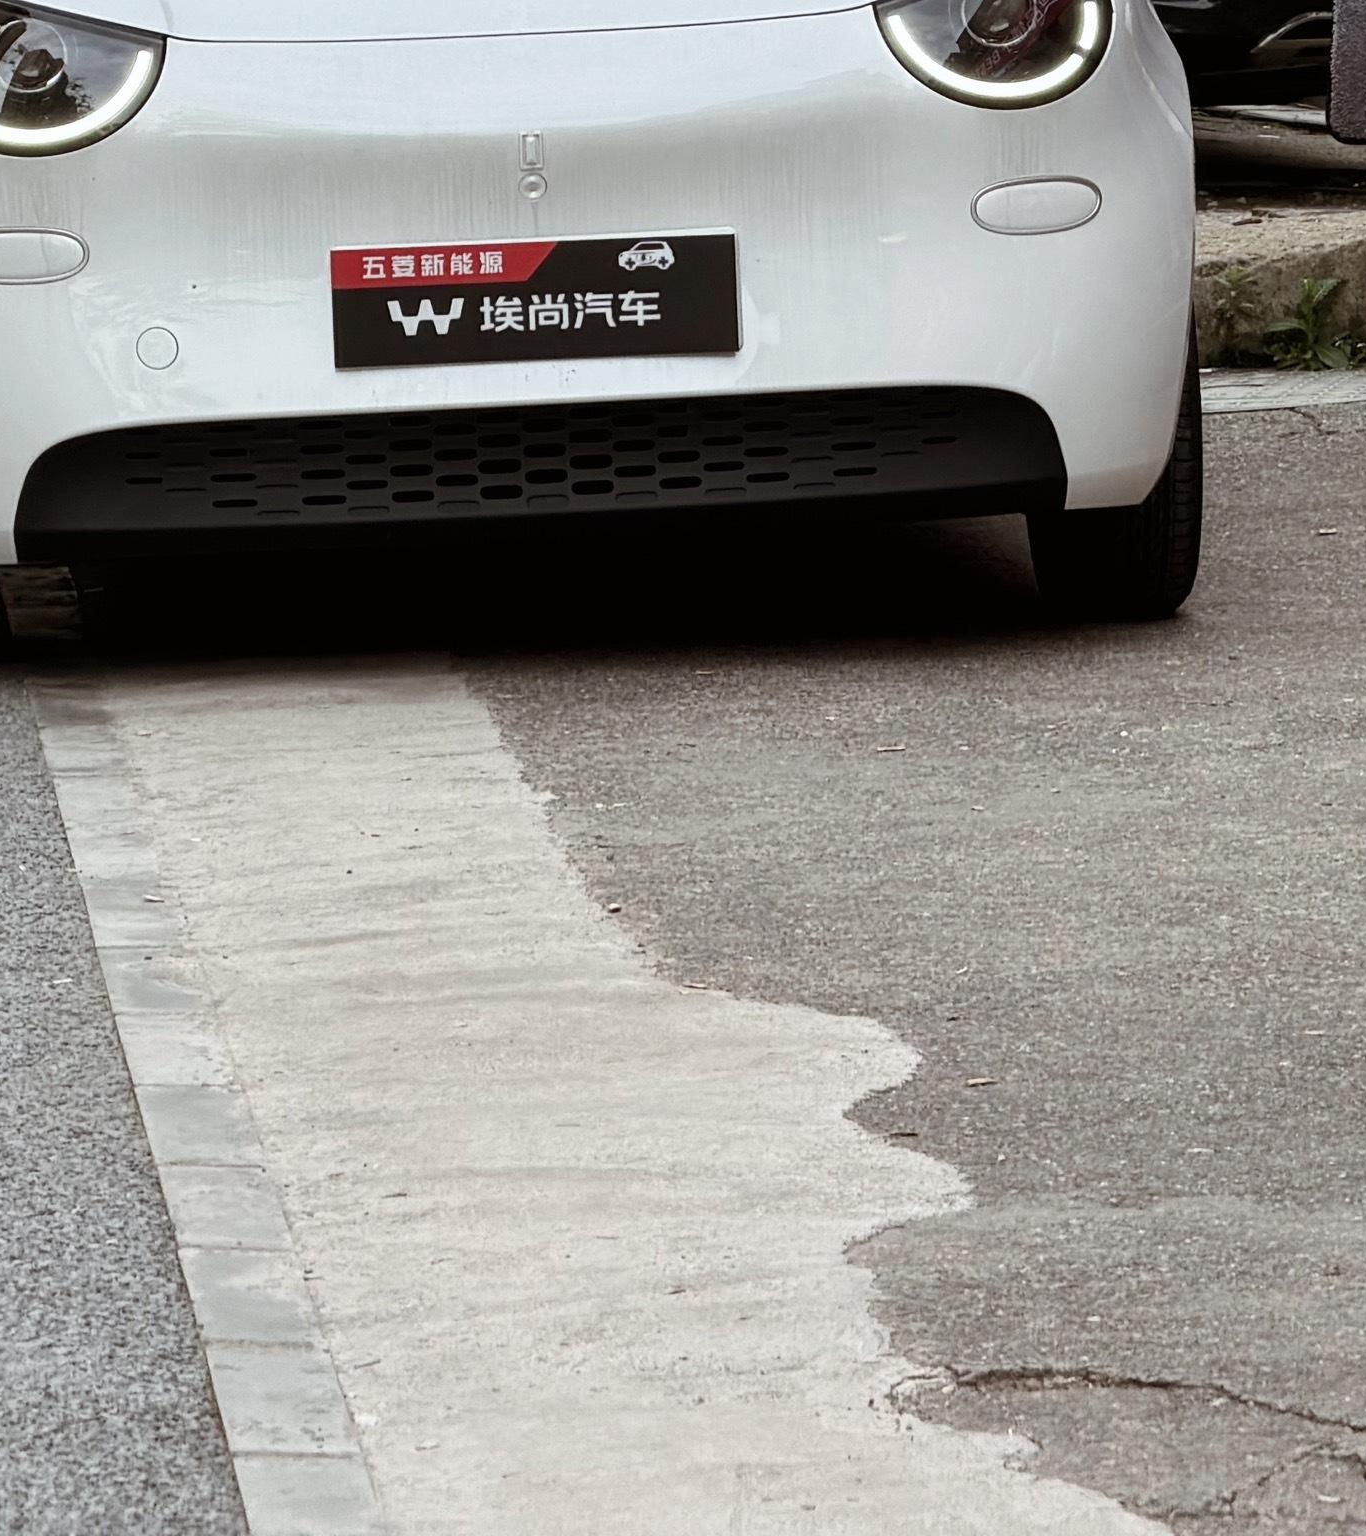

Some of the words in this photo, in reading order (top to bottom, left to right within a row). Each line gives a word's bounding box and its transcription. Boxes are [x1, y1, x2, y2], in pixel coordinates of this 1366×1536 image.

[362, 250, 504, 280] 五菱新能源
[479, 289, 662, 333] 埃尚汽车
